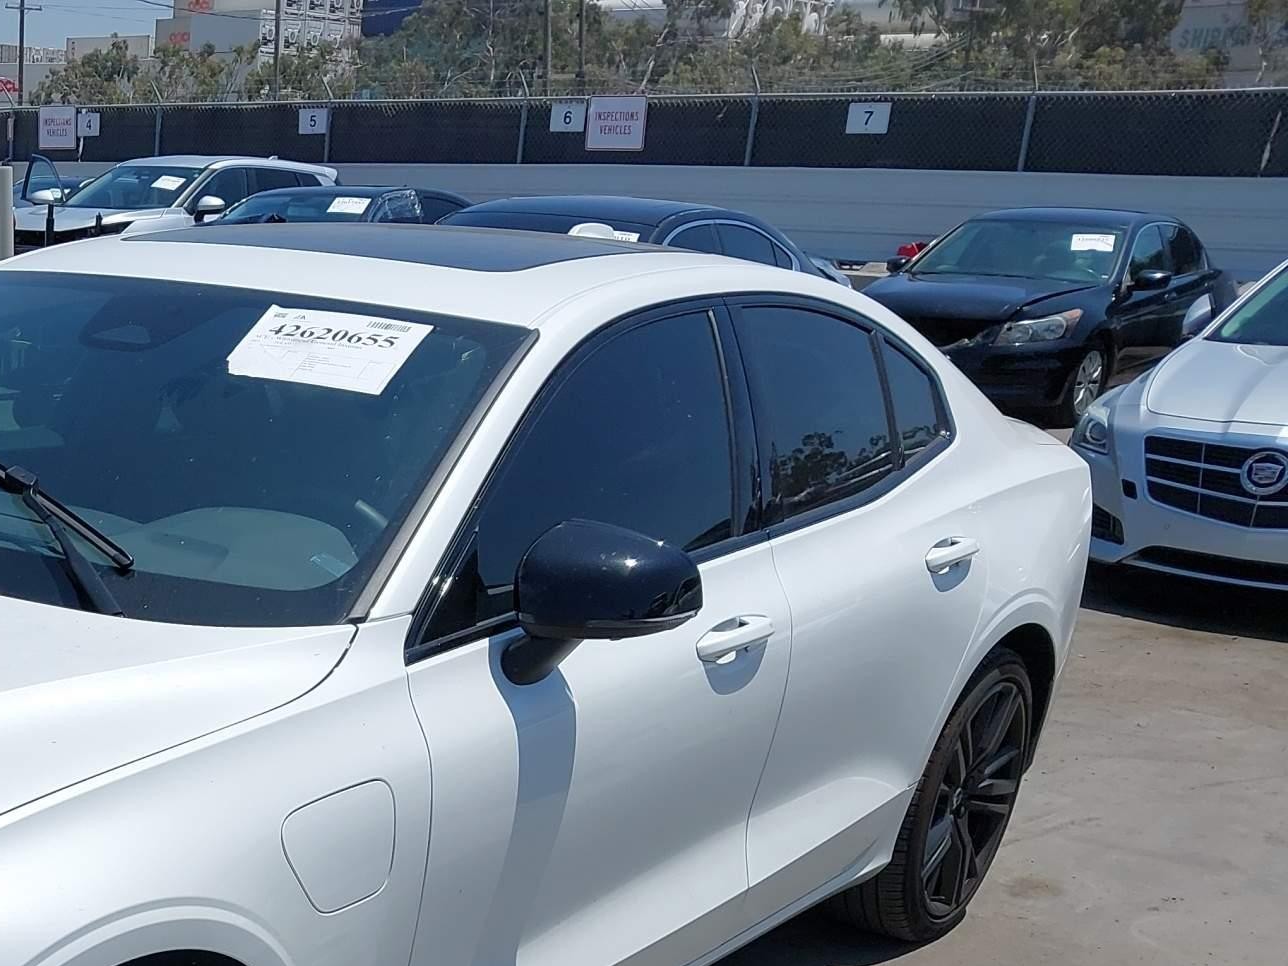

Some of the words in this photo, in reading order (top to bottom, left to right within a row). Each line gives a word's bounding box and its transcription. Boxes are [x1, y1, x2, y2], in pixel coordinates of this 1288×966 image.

[309, 114, 317, 128] 5
[563, 110, 573, 125] 6
[594, 111, 639, 121] INSPECTIONS
[864, 110, 874, 126] 7
[85, 119, 92, 131] 4
[599, 124, 632, 135] VEHICLES
[268, 323, 400, 349] 42620655
